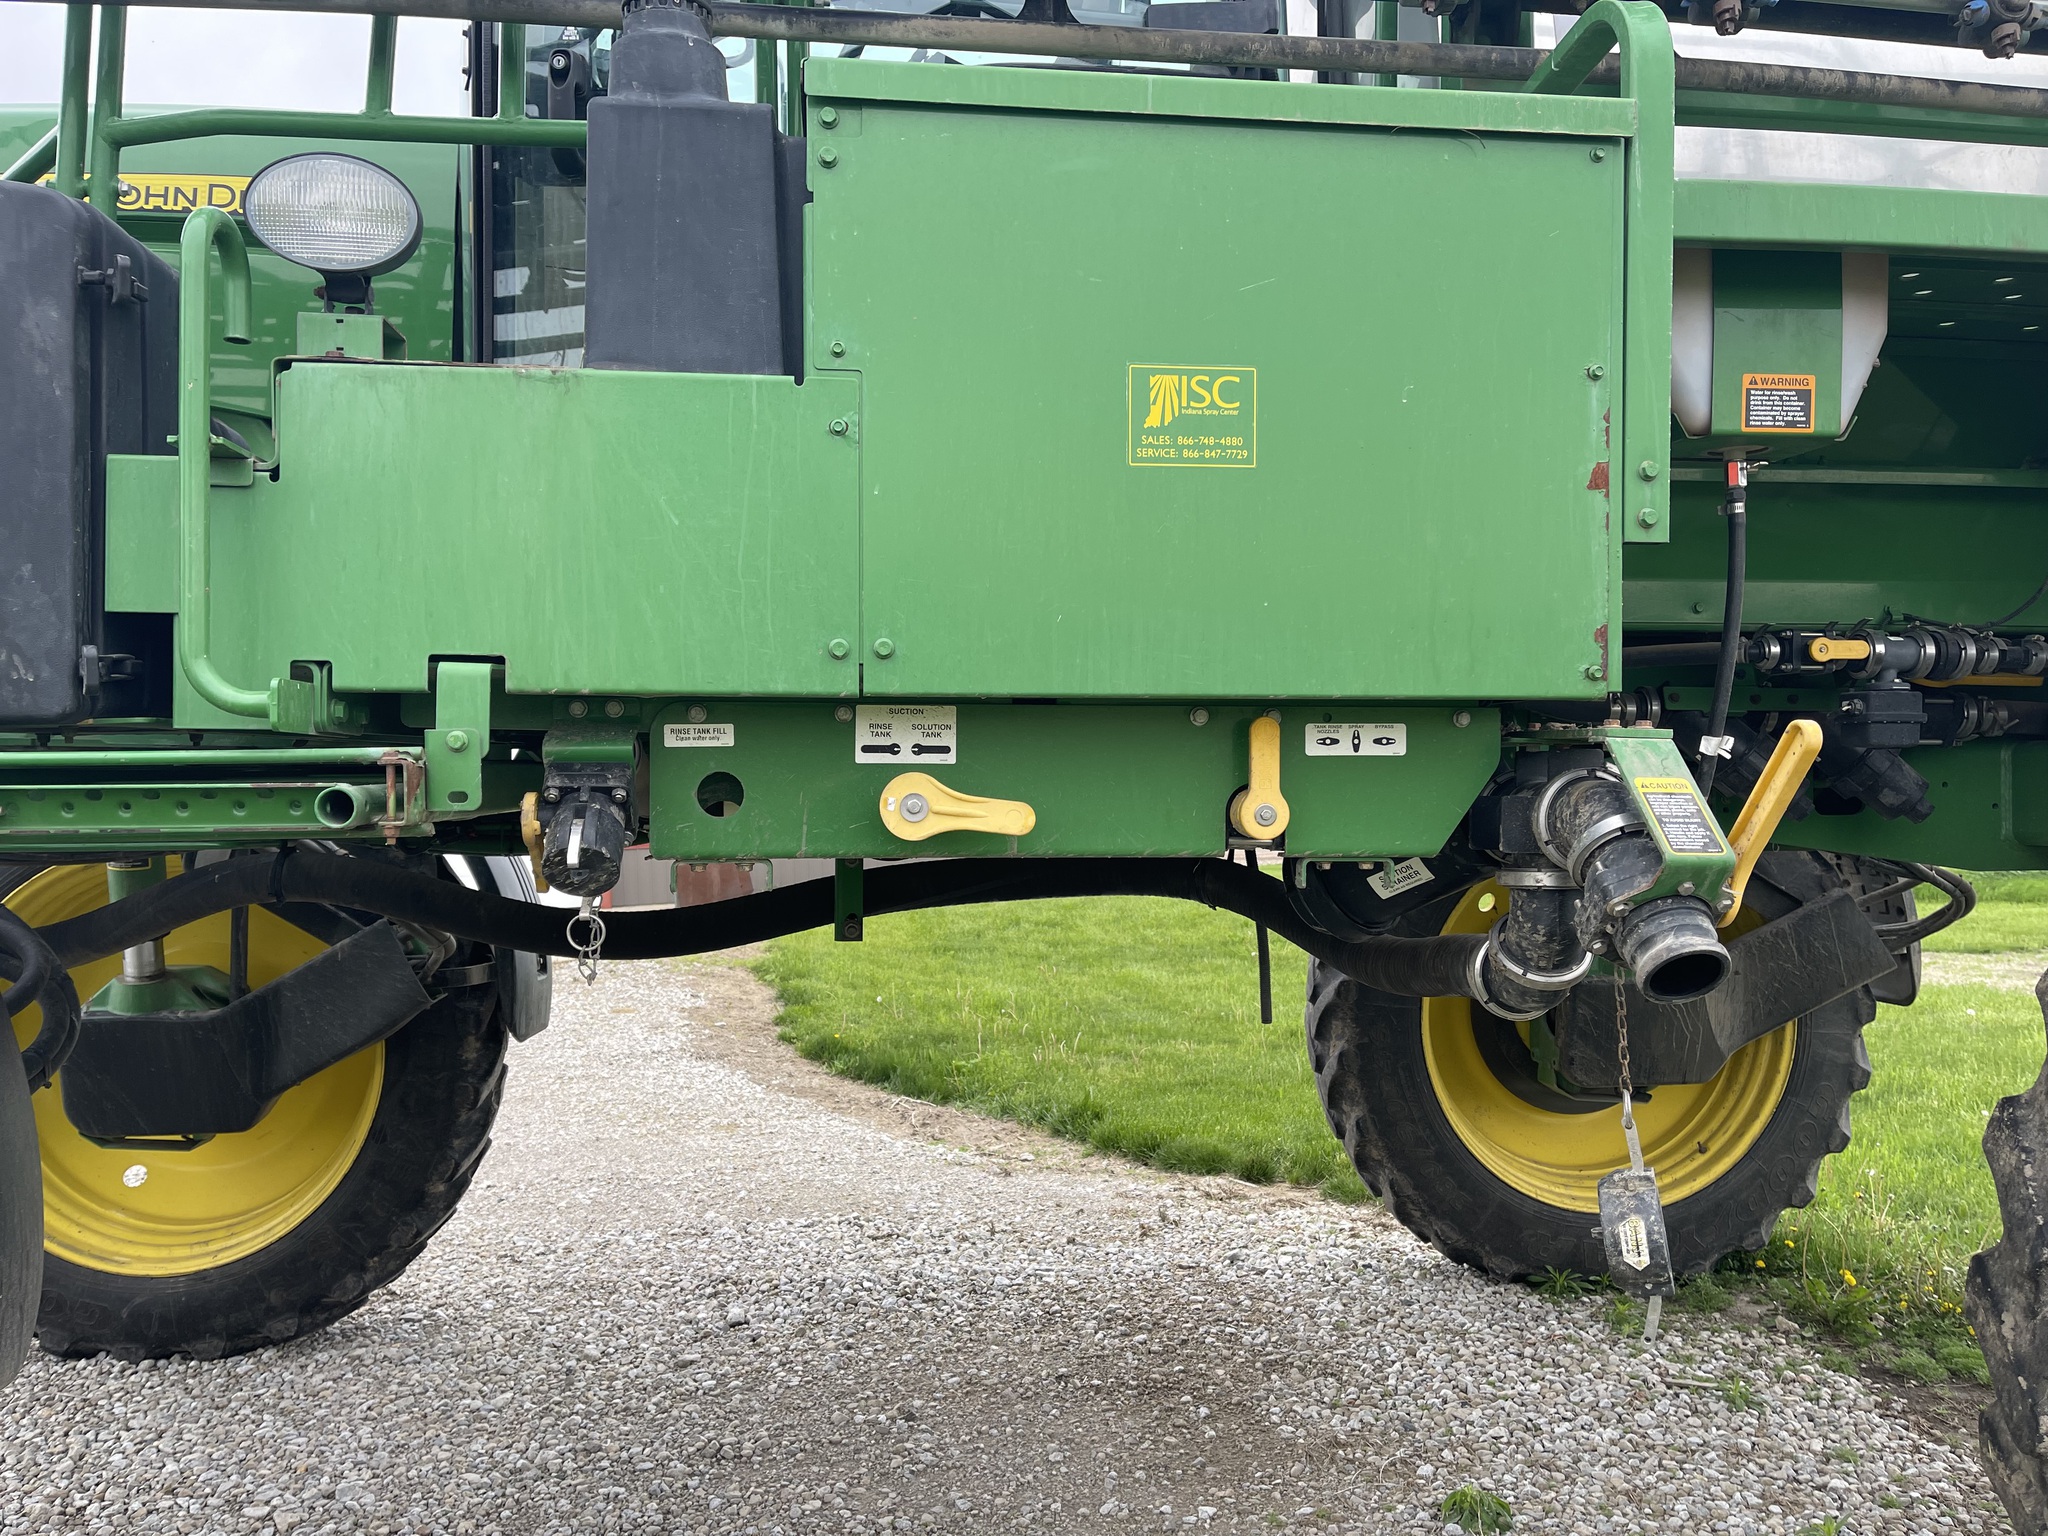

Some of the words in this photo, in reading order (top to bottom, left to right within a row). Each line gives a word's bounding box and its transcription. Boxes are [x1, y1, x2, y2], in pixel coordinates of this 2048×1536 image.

[1761, 378, 1809, 386] WARNING
[1182, 375, 1240, 408] ISC
[1142, 436, 1173, 444] SALES:
[1178, 436, 1243, 446] 866-748-4880
[1137, 448, 1178, 457] SERVICE:
[1183, 449, 1247, 458] 866-847-7729
[1379, 864, 1413, 883] STION
[1382, 870, 1421, 890] SAINER
